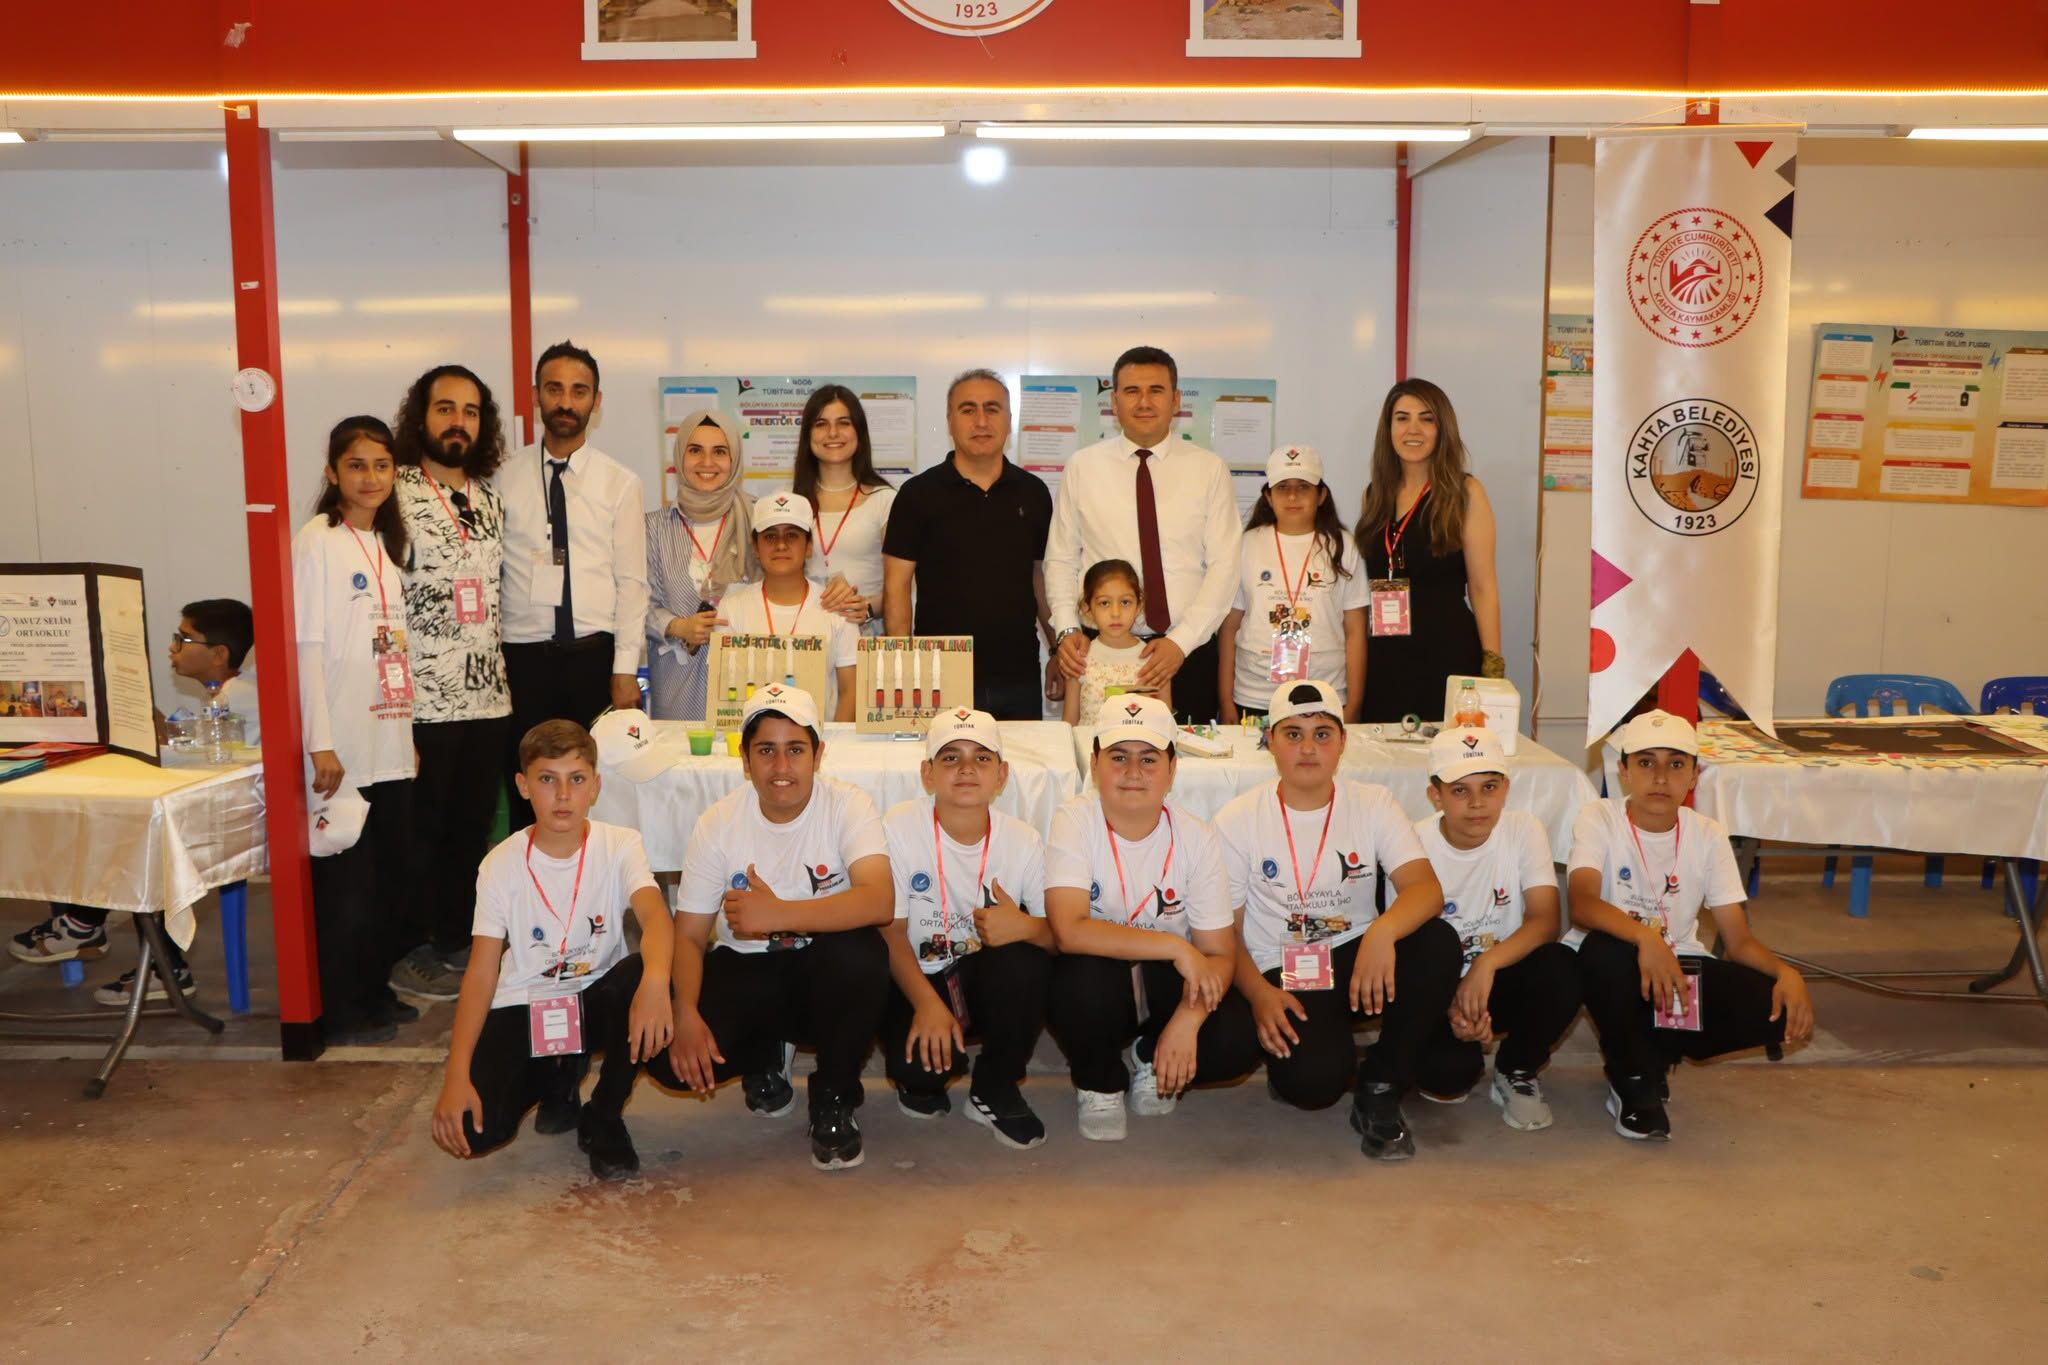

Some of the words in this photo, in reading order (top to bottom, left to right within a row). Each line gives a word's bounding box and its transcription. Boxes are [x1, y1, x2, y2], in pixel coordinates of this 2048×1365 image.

[955, 3, 998, 18] 1923
[1653, 236, 1685, 268] TÜRKİYE
[1684, 233, 1741, 267] CUMHURİYETİ
[1654, 291, 1677, 318] KAHTA
[1677, 291, 1738, 323] KAYMAKAMLIĞI
[1633, 417, 1671, 479] KAHTA
[1672, 406, 1756, 480] BELEDİYESİ
[1674, 514, 1718, 530] 1923
[13, 616, 41, 625] YAVUZ
[43, 615, 72, 625] SELİM
[15, 629, 72, 638] ORTAOKULU
